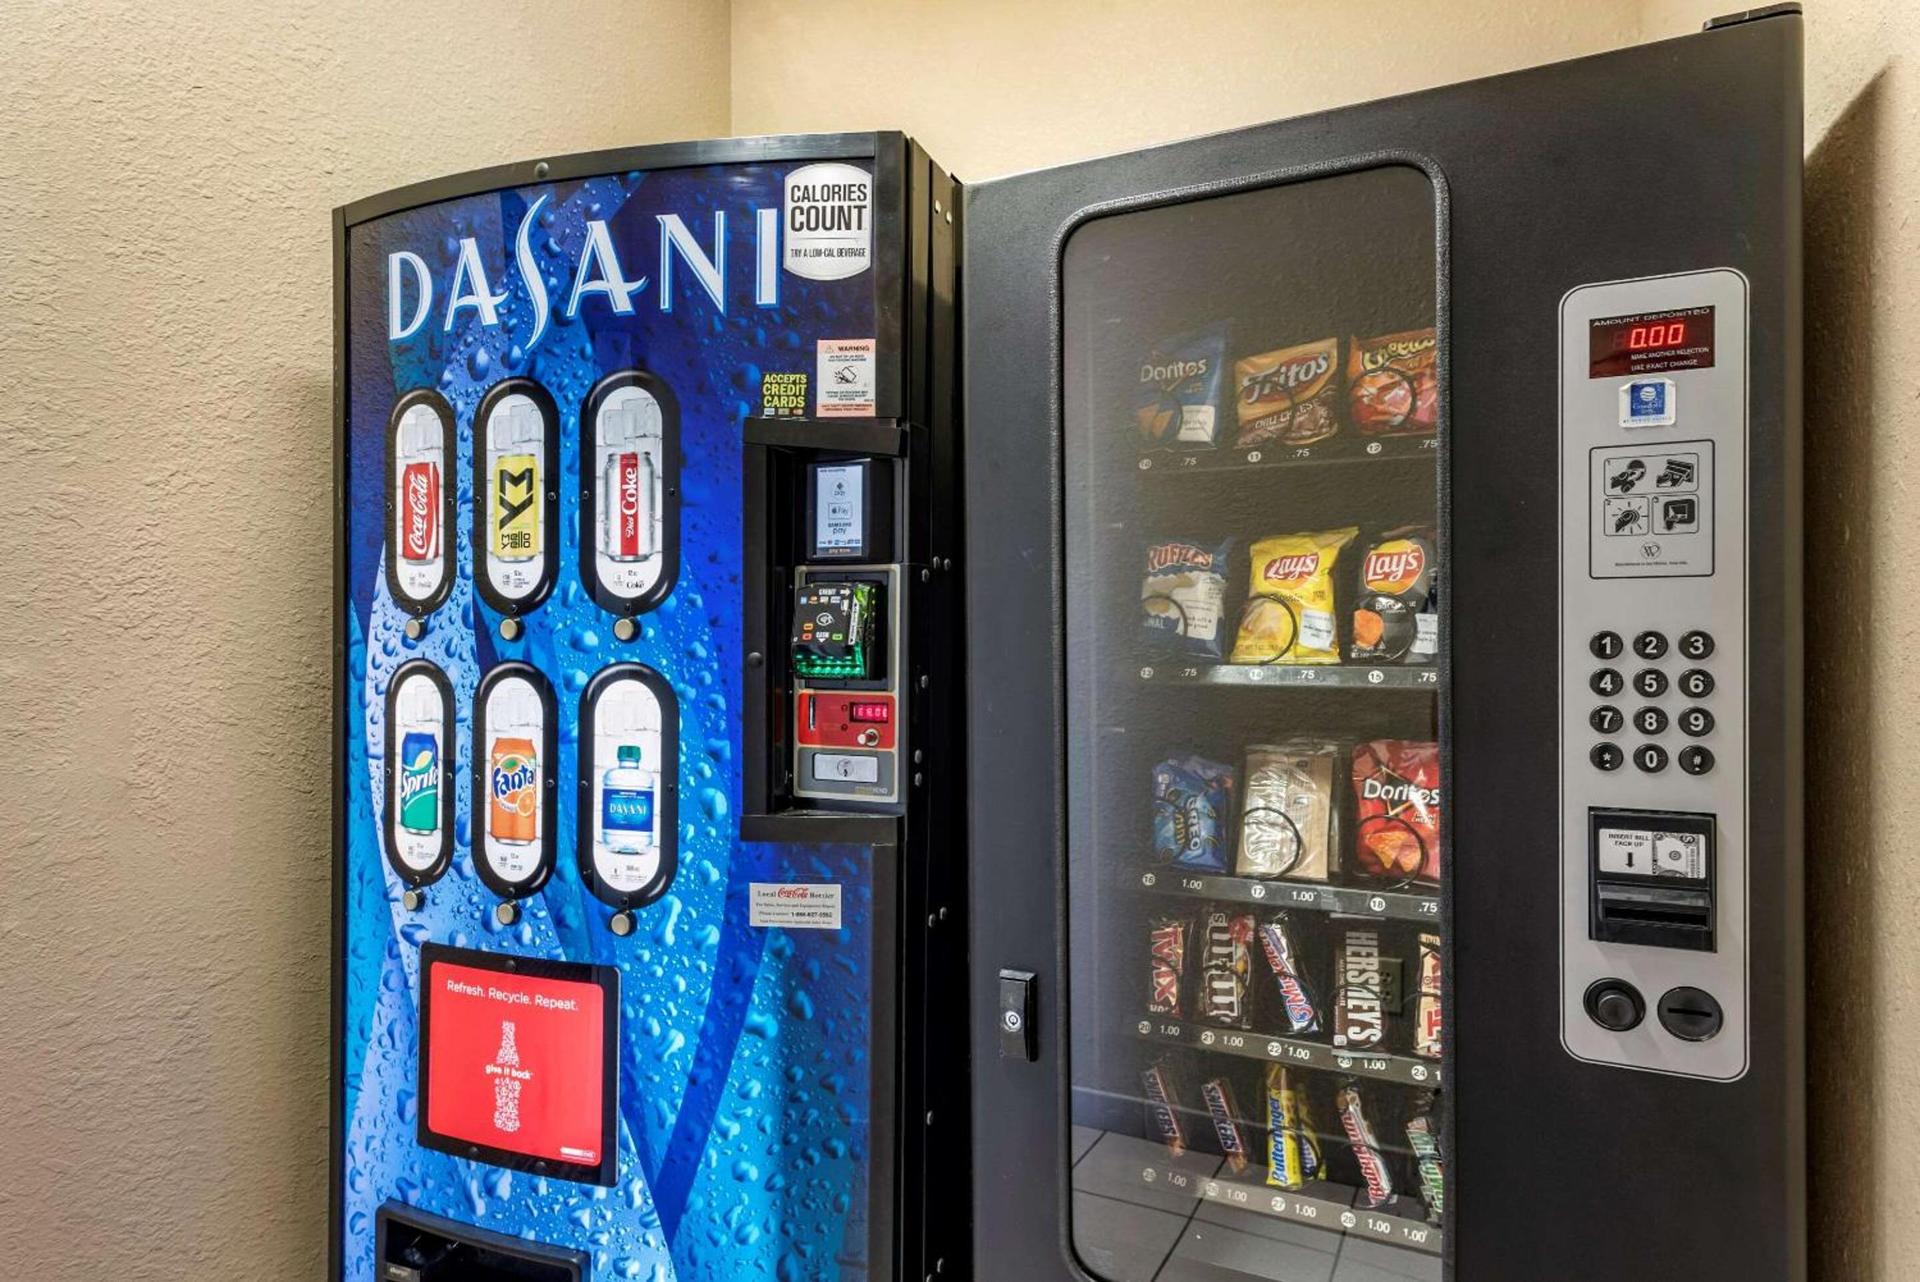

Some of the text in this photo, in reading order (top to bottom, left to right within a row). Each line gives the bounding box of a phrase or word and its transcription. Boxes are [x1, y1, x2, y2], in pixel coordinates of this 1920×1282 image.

[790, 183, 867, 203] CALORIES
[790, 204, 867, 232] COUNT
[791, 248, 802, 258] TRY
[836, 246, 866, 257] BEVERAGE
[388, 194, 777, 350] DASANI
[1593, 308, 1710, 327] AMOUNT DEPOSITED
[1630, 323, 1684, 349] 0.00
[838, 344, 870, 352] WARNING
[1140, 359, 1207, 382] Doritos
[1646, 361, 1668, 371] EXACT
[1670, 358, 1699, 369] CHANGE
[763, 374, 807, 383] ACCEPTS
[1242, 352, 1328, 404] Fritos
[763, 384, 808, 396] CREDIT
[764, 396, 805, 408] CARDS
[621, 467, 637, 515] Coke
[408, 470, 429, 555] Coca-Cola
[1266, 554, 1319, 580] Lay's
[1367, 549, 1420, 582] Lay's
[1601, 636, 1704, 654] 1 2 3
[1181, 668, 1197, 677] .75
[1298, 670, 1315, 679] .75
[1418, 673, 1437, 683] .75
[1600, 674, 1704, 693] 4 5 6
[1600, 711, 1704, 731] 7 8 9
[1645, 750, 1658, 768] 0
[402, 768, 439, 799] Sprite
[1363, 778, 1440, 805] Doritos
[609, 802, 647, 815] DASANI
[1181, 878, 1202, 890] 1.00
[1291, 891, 1314, 902] 1.00
[1418, 902, 1438, 912] .75
[447, 980, 578, 1011] Refresh. Recycle. Repeat.
[1346, 931, 1382, 1044] HERSHEY'S
[1160, 1025, 1180, 1036] 1.00
[1223, 1036, 1244, 1047] 1.00
[1287, 1046, 1310, 1060] 1.00
[485, 1064, 531, 1080] give it back
[1363, 1060, 1386, 1070] 1.00
[1204, 1082, 1240, 1151] SNICKERS
[1168, 1172, 1186, 1187] 1.00
[1227, 1189, 1247, 1201] 1.00
[1294, 1204, 1316, 1218] 1.00
[1367, 1219, 1391, 1234] 1.00
[1403, 1228, 1426, 1243] 1.00
